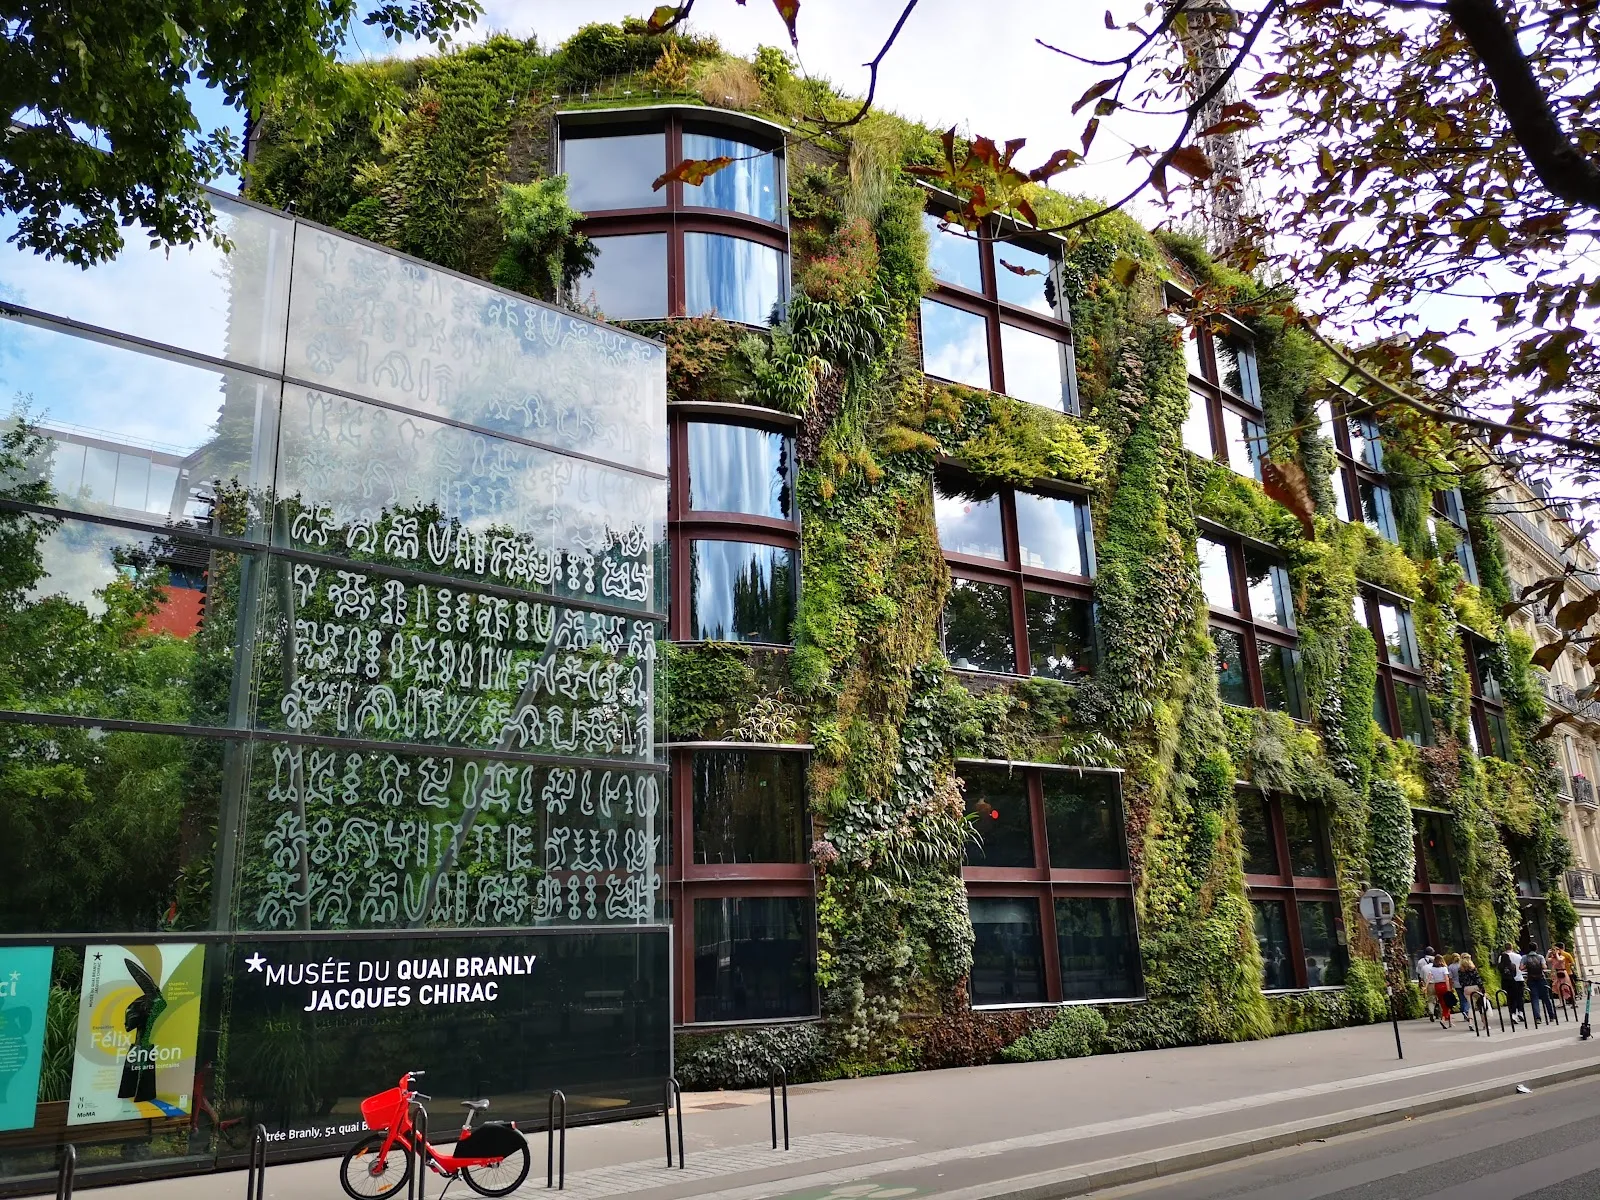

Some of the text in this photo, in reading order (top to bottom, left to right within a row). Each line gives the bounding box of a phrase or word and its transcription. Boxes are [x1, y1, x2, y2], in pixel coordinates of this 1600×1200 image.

[265, 955, 537, 986] MUSÉE DU QUAI BRANLY
[304, 981, 498, 1012] JACQUES CHIRAC
[90, 1031, 132, 1049] Félix
[115, 1045, 181, 1064] Fénéon
[143, 1063, 154, 1071] arts
[256, 1131, 286, 1143] trée
[289, 1127, 323, 1140] Branly,
[325, 1127, 336, 1138] 51
[339, 1122, 360, 1136] quai
